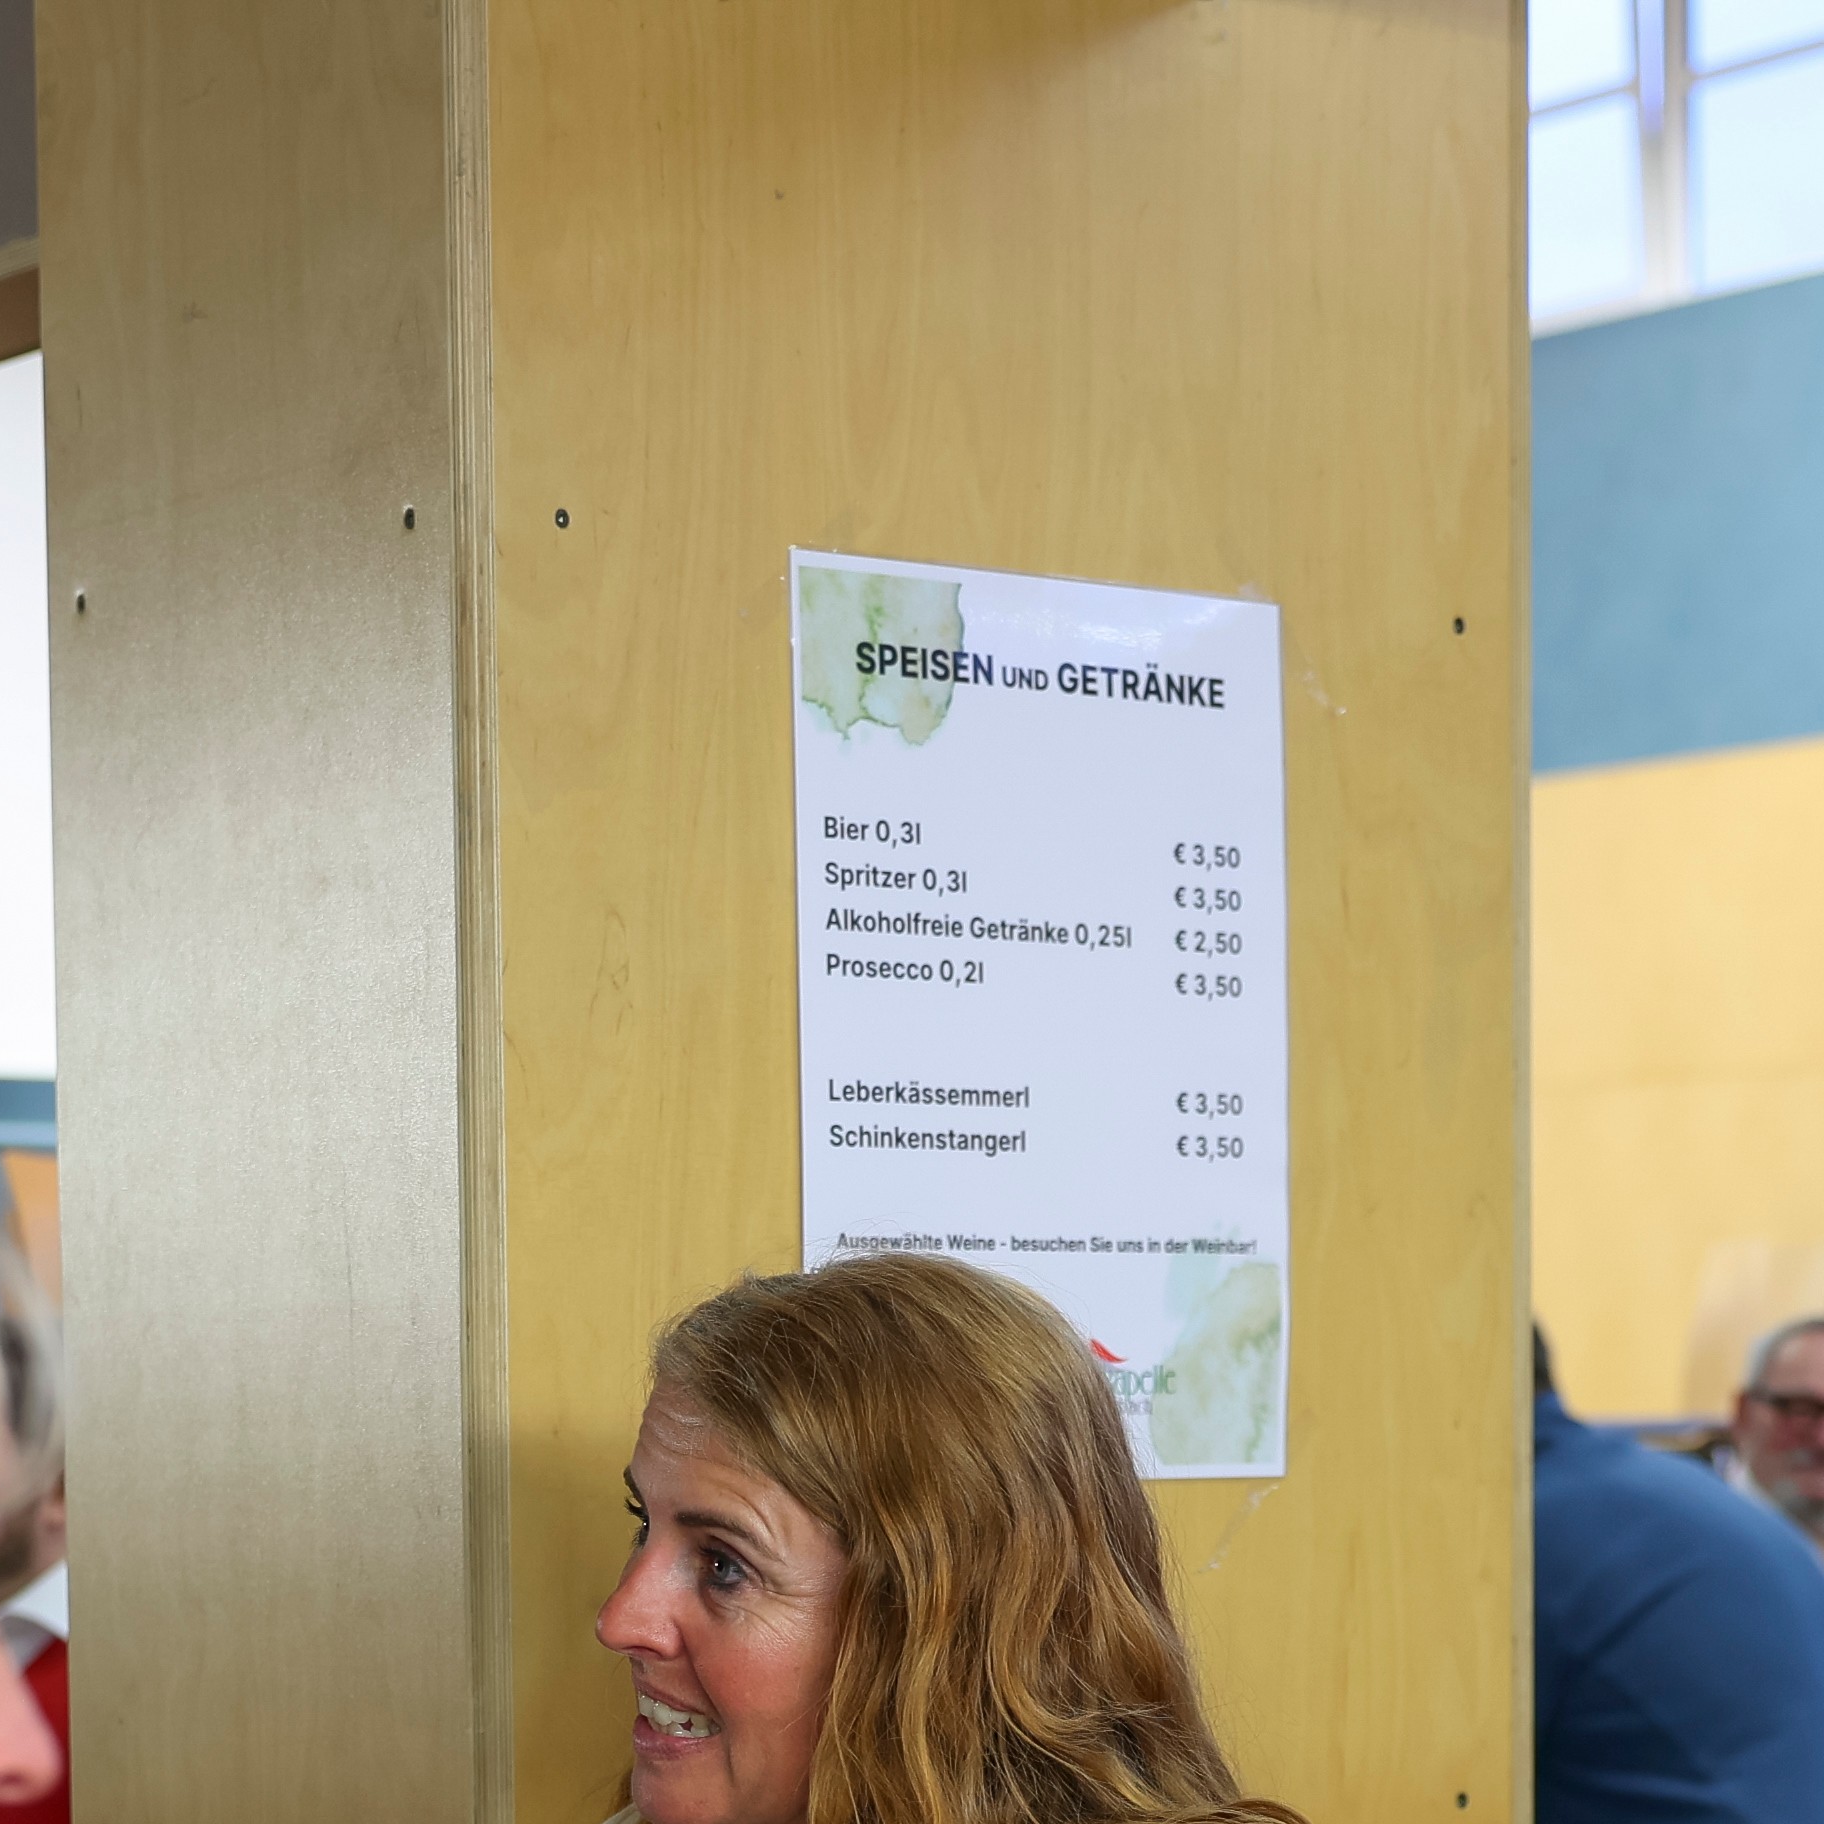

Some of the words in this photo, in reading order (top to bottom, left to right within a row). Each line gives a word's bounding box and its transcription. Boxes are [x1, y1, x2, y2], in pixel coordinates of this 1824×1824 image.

[856, 642, 994, 686] SPEISEN
[1002, 666, 1048, 690] UND
[1057, 662, 1224, 708] GETRÄNKE
[824, 817, 869, 841] Bier
[1174, 843, 1185, 864] €
[1193, 845, 1240, 871] 3,50
[825, 863, 916, 890] Spritzer
[1174, 887, 1186, 907] €
[1194, 888, 1241, 914] 3,50
[826, 909, 963, 937] Alkoholfreie
[970, 917, 1068, 945] Getränke
[1175, 930, 1187, 951] €
[1194, 932, 1242, 958] 2,50
[826, 954, 933, 981] Prosecco
[1176, 974, 1187, 994] €
[1195, 975, 1242, 1001] 3,50
[829, 1079, 1030, 1107] Leberkässemmerl
[1177, 1092, 1188, 1113] €
[1196, 1094, 1243, 1120] 3,50
[830, 1125, 1025, 1157] Schinkenstangerl
[1177, 1136, 1189, 1156] €
[1196, 1138, 1244, 1162] 3,50
[946, 1234, 996, 1251] Weine
[1011, 1236, 1087, 1252] besuchen
[1090, 1237, 1113, 1253] Sie
[1117, 1241, 1144, 1253] uns
[1147, 1237, 1161, 1253] in
[1164, 1239, 1188, 1254] der
